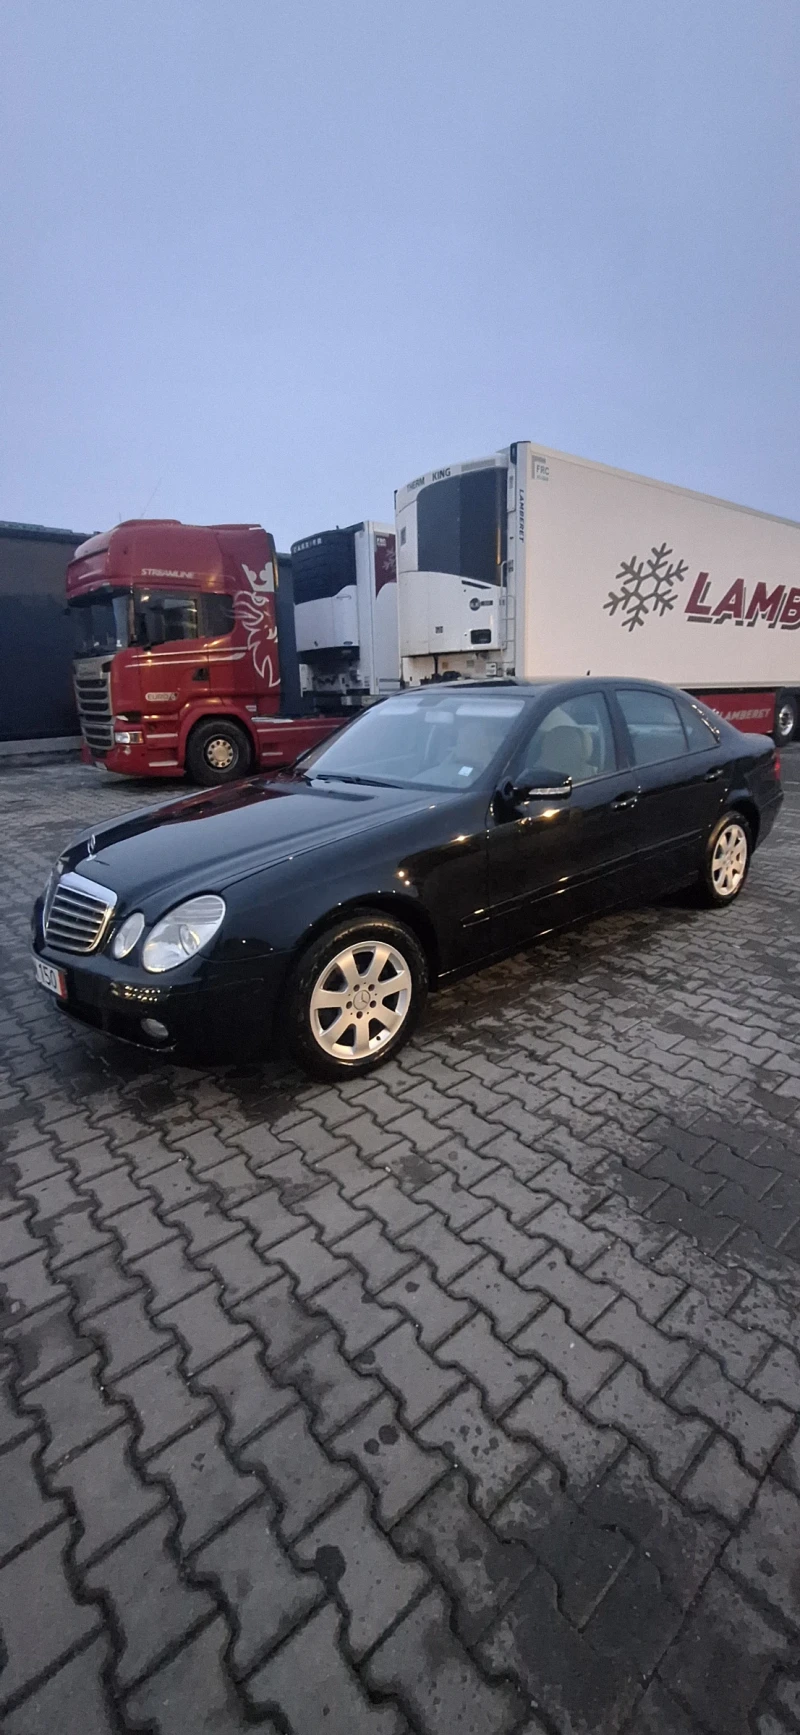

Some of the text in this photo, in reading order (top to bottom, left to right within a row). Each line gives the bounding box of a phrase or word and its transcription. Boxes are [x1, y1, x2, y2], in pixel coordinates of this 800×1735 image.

[432, 467, 451, 482] KING
[536, 464, 550, 475] FRC
[141, 568, 195, 579] STREAMLINE
[684, 571, 800, 629] LAMB
[38, 963, 58, 989] 150
